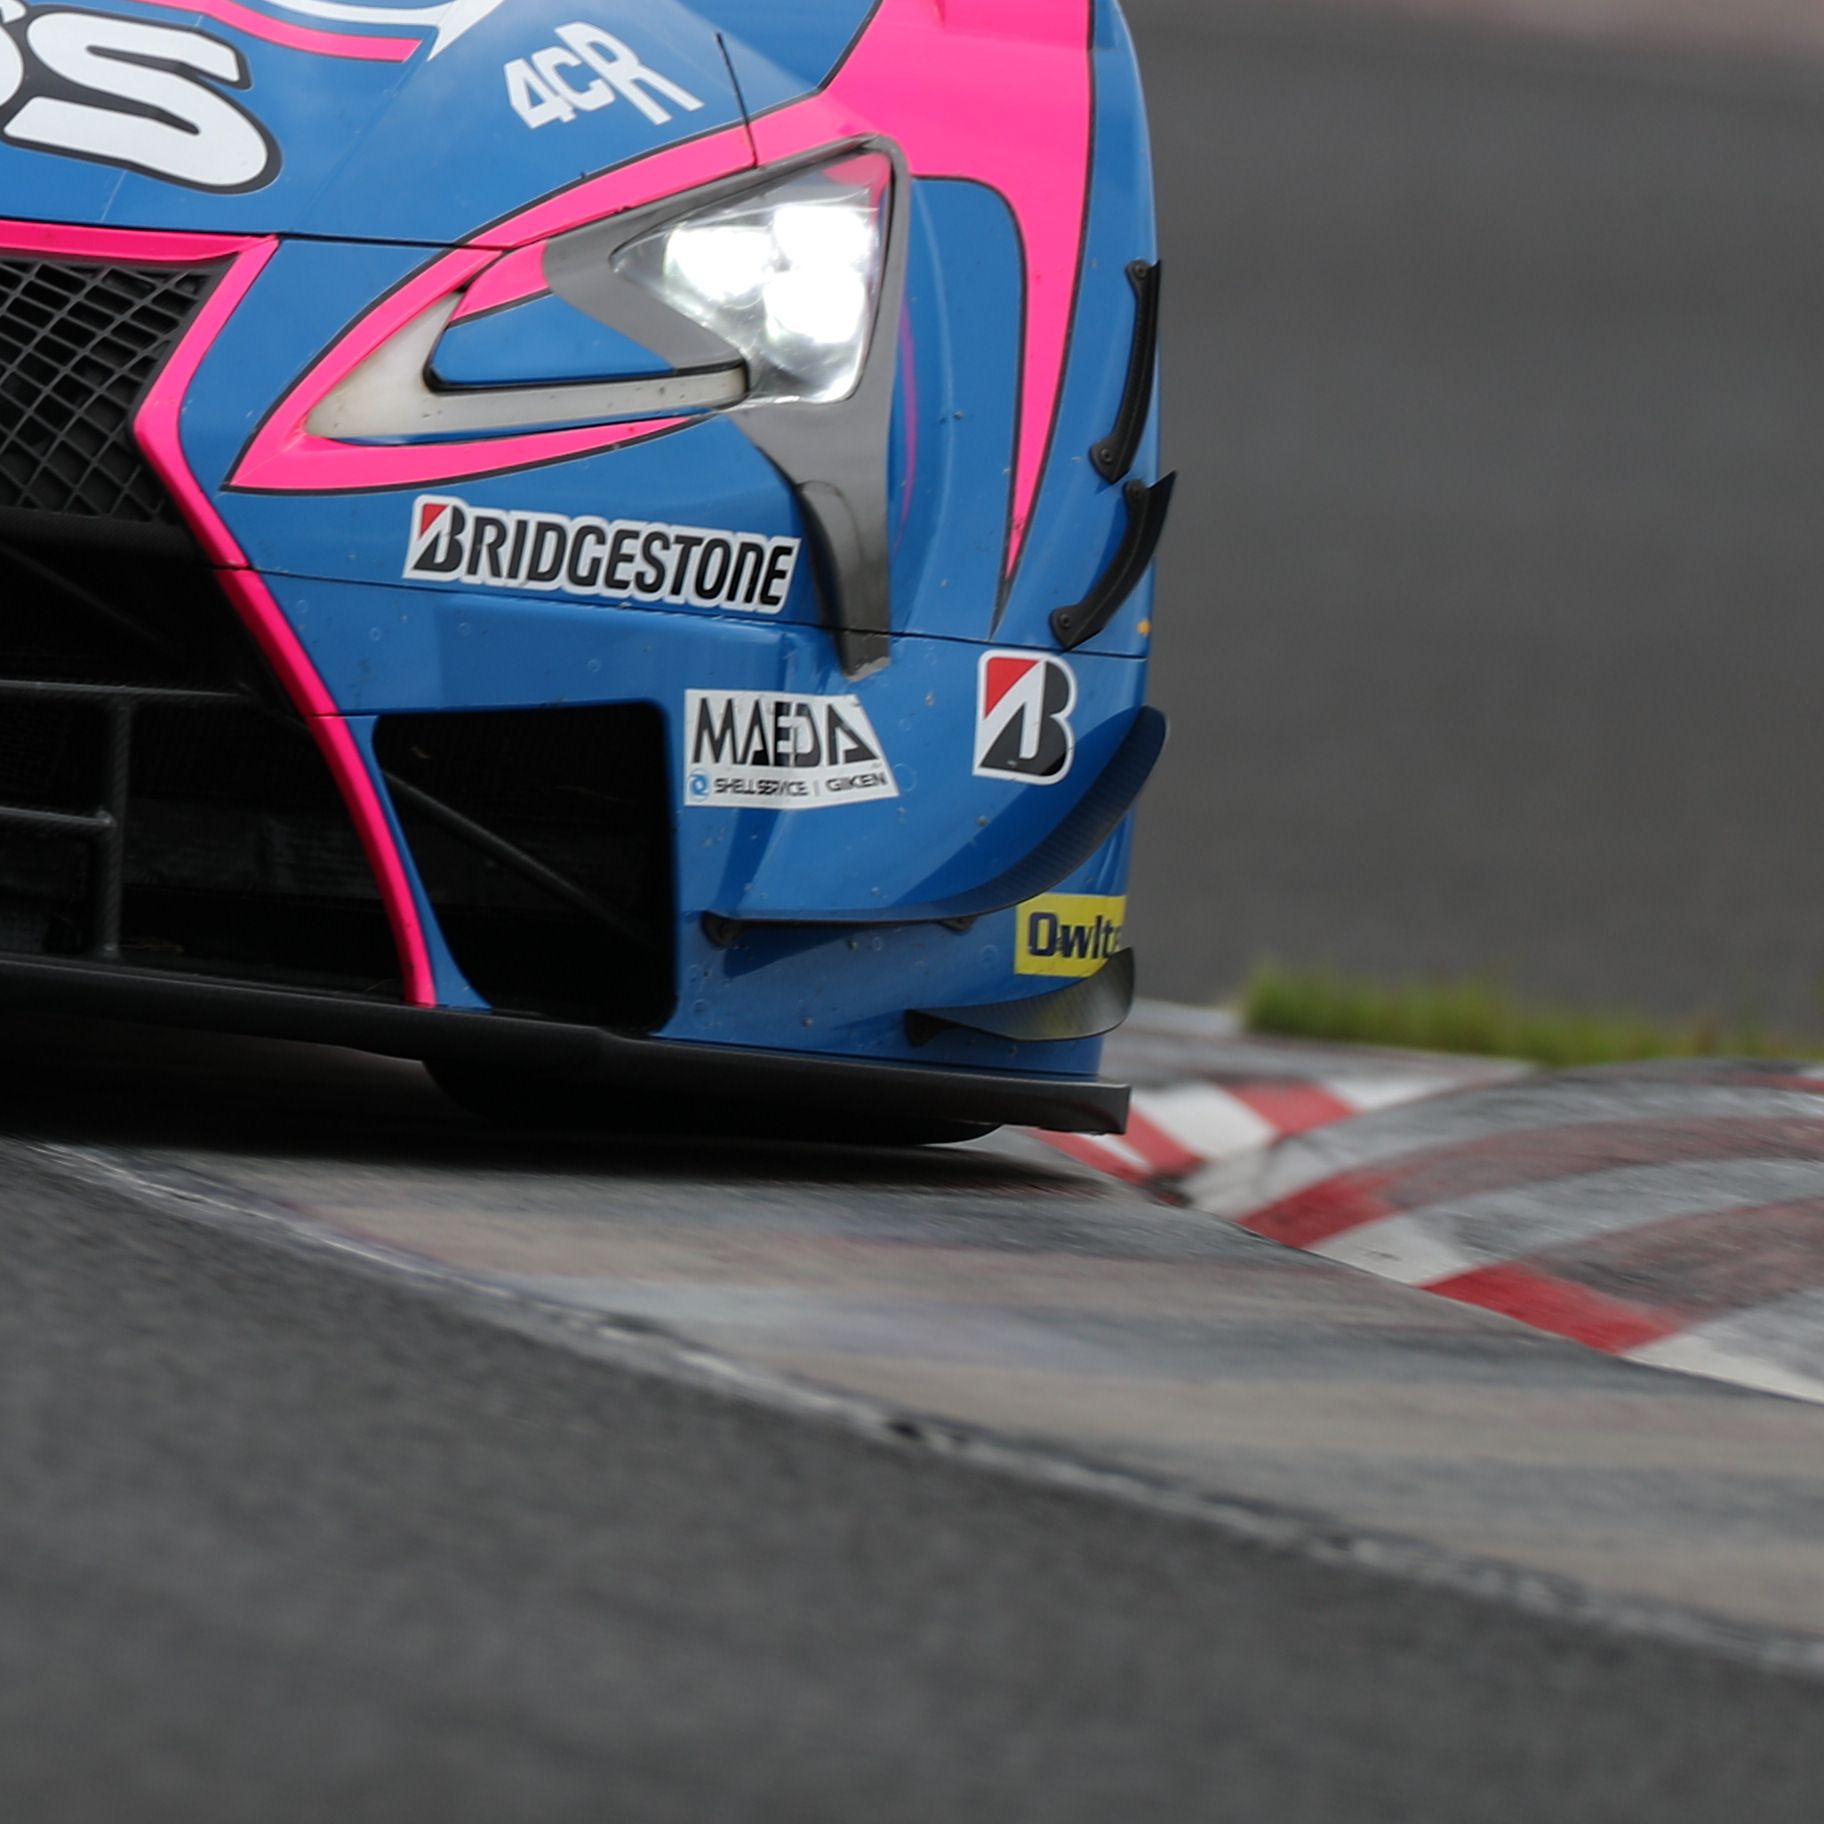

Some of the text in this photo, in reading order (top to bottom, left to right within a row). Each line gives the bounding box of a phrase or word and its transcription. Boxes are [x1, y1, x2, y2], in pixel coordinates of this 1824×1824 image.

[503, 20, 706, 130] 4CR
[412, 502, 795, 606] BRIDGESTONE
[692, 696, 881, 768] MAEDA
[713, 778, 757, 795] SHELL
[825, 771, 889, 793] GIKEN
[1028, 911, 1121, 959] Owlt
